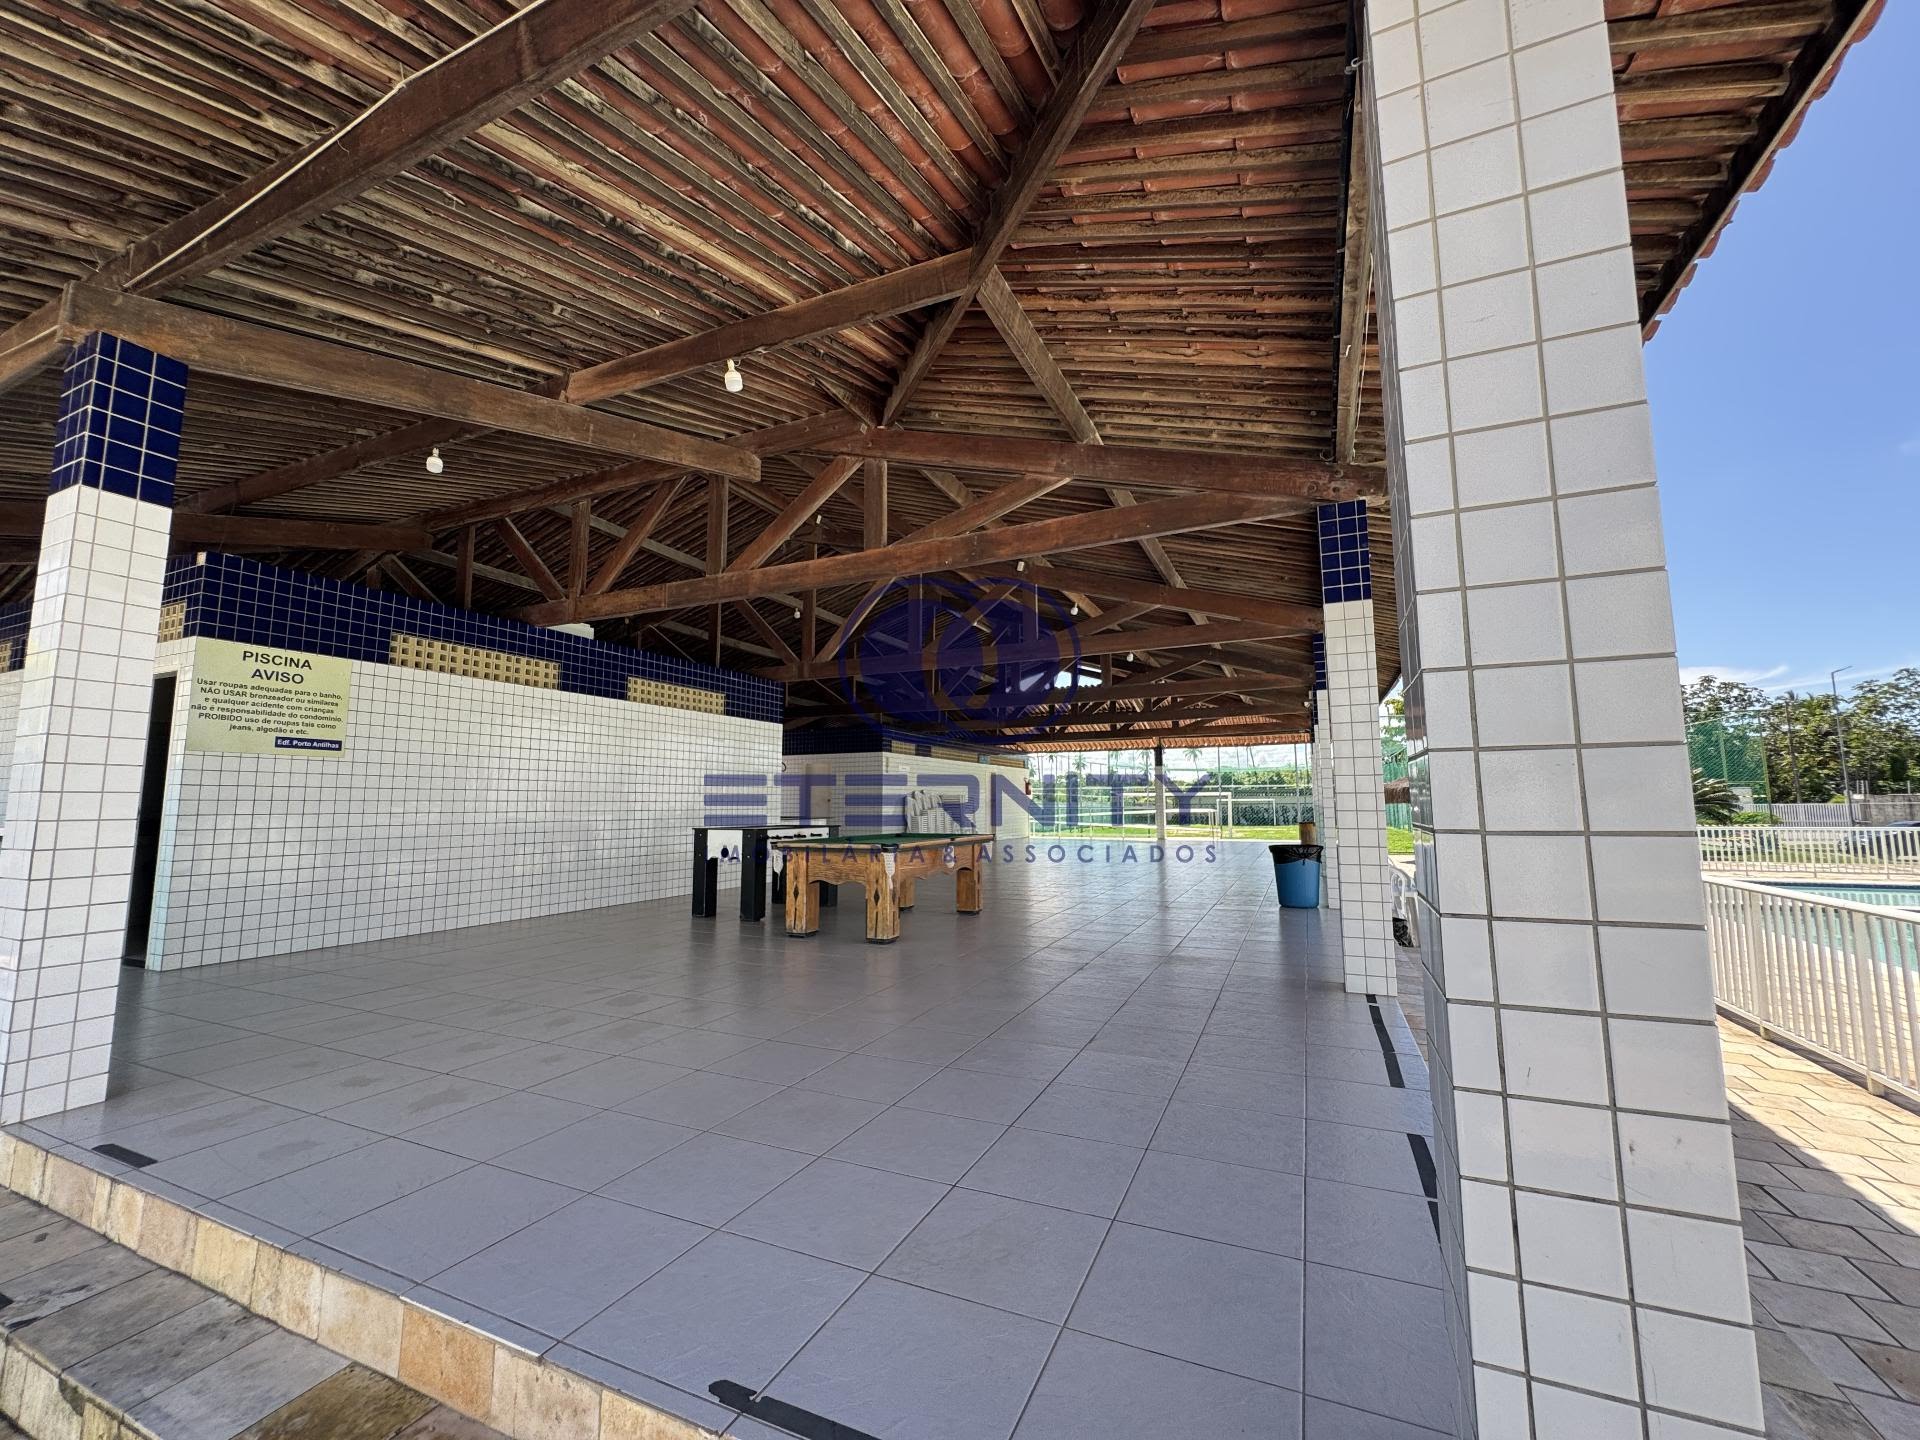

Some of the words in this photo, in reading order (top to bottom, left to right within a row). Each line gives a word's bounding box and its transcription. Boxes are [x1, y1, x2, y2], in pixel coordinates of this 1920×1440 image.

[243, 651, 312, 670] PISCINA
[251, 669, 304, 684] AVISO
[197, 678, 217, 686] Usar
[251, 684, 292, 694] adequadas
[320, 692, 342, 700] banho,
[201, 686, 220, 695] NÃO
[223, 689, 247, 697] USAR
[250, 692, 293, 702] bronzeador
[307, 698, 338, 707] similares
[212, 697, 249, 706] qualquer
[251, 700, 284, 709] acidente
[305, 706, 334, 714] crianças
[217, 707, 286, 718] responsabilidade
[199, 712, 242, 721] PROIBIDO
[230, 724, 253, 732] jeans,
[256, 726, 287, 734] algodão
